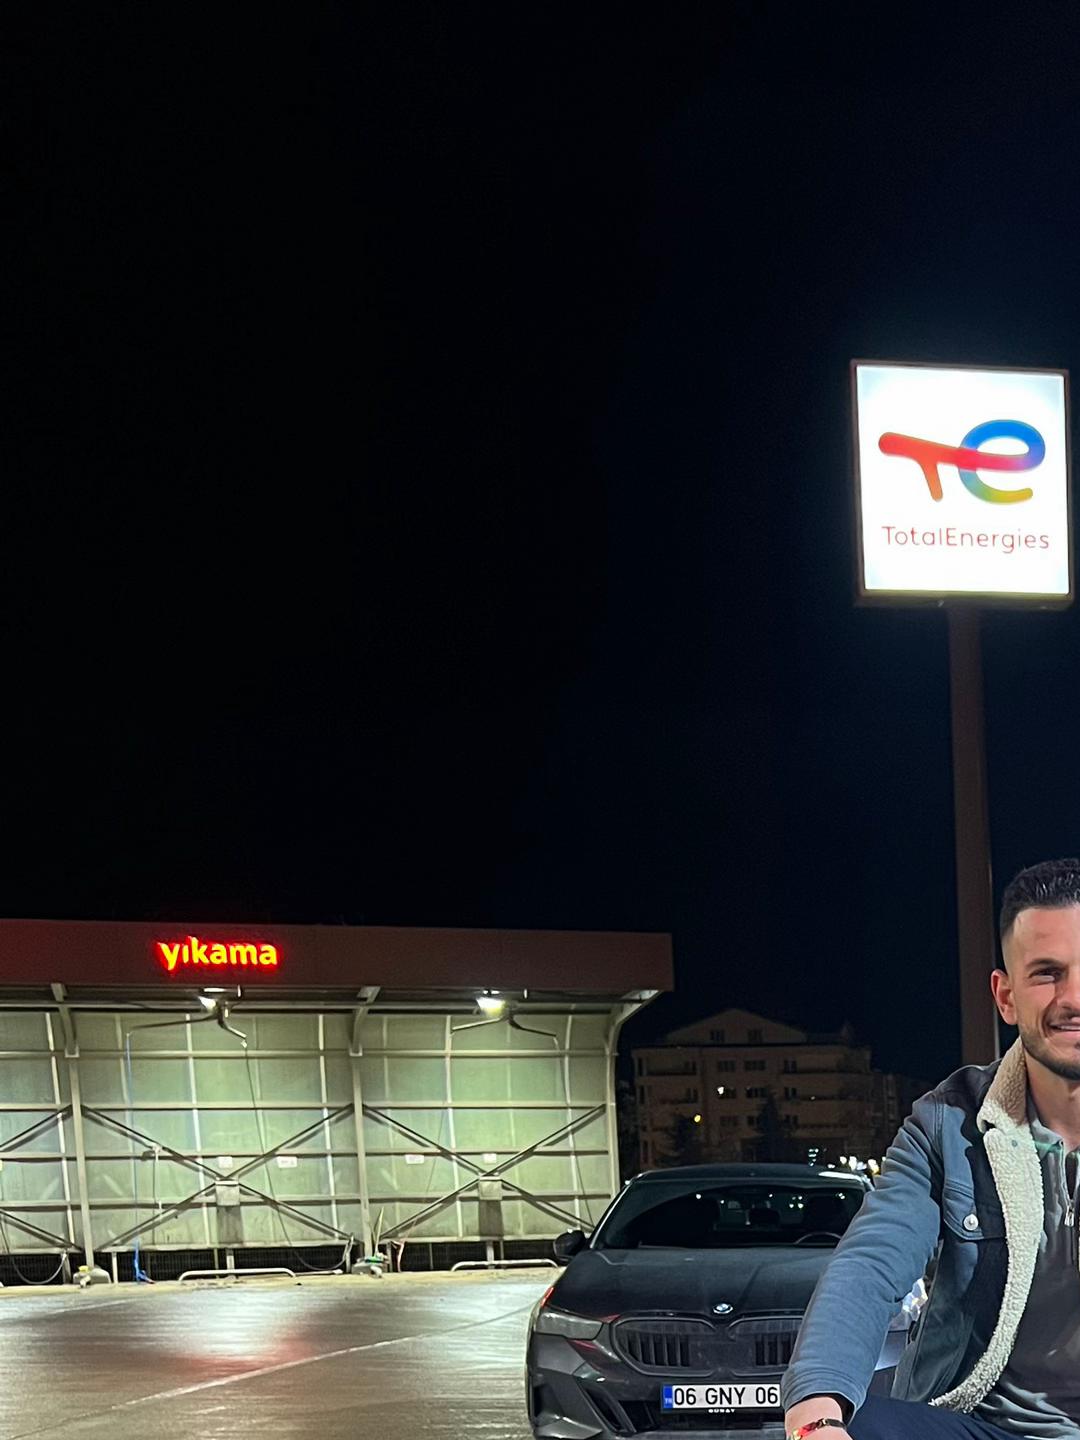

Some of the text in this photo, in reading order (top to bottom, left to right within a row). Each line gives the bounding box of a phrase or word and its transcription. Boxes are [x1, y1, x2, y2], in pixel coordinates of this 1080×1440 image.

[881, 526, 1050, 554] TotalEnergies
[157, 935, 278, 971] yıkama
[674, 1388, 697, 1405] 06
[705, 1387, 746, 1405] GNY
[755, 1387, 778, 1404] 06
